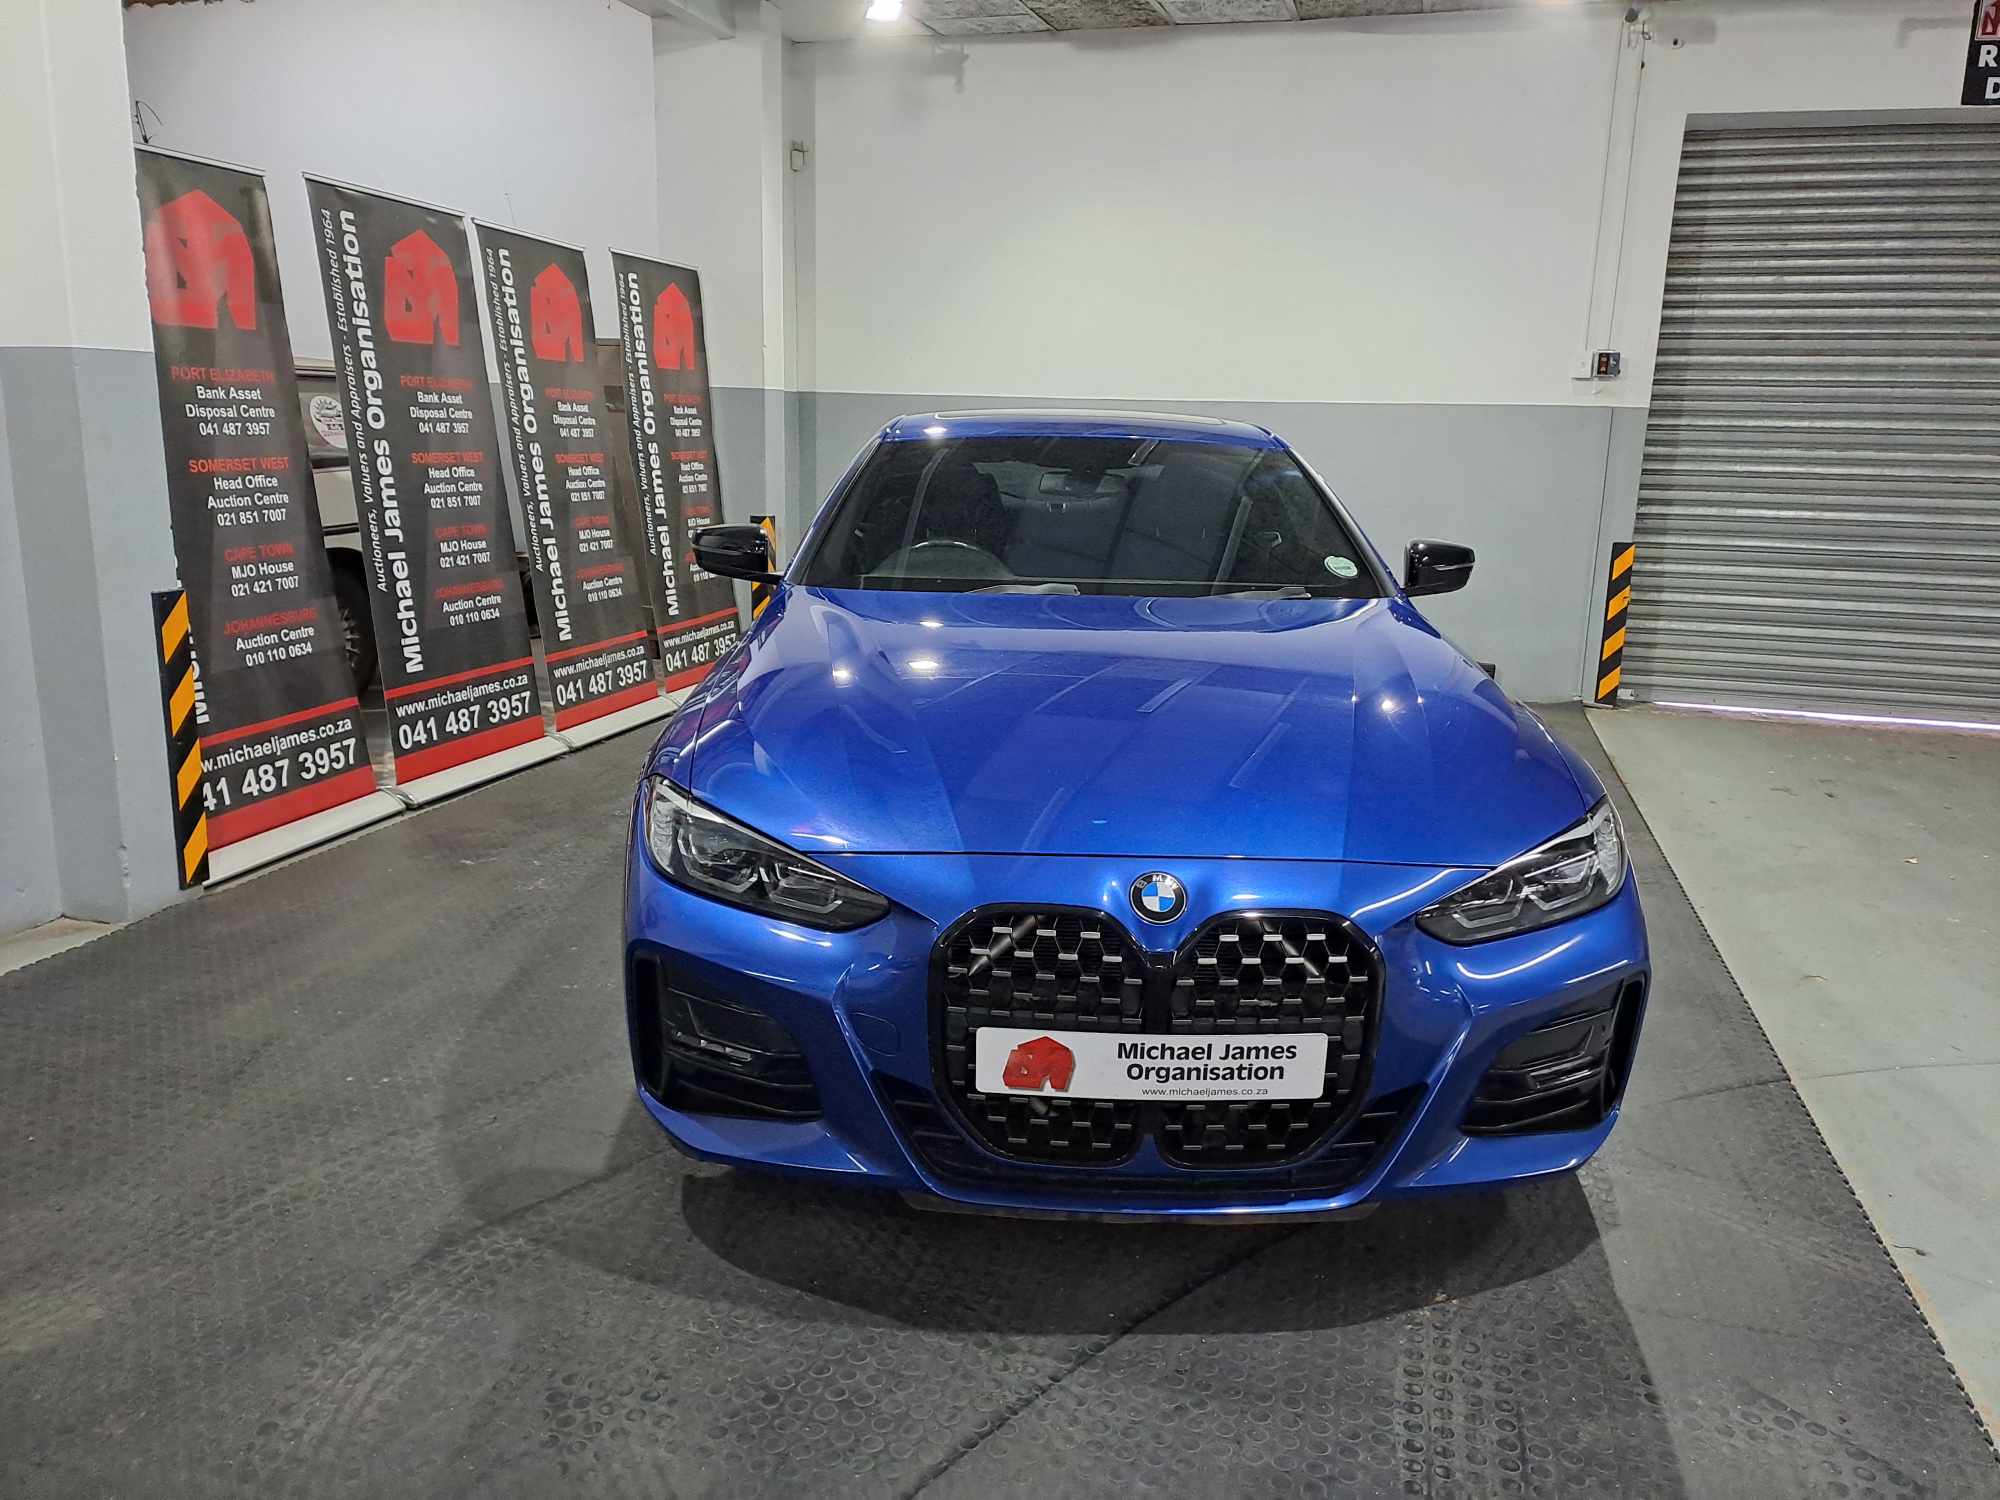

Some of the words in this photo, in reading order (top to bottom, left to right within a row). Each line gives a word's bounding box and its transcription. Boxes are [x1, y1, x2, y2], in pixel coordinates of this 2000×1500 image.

[321, 208, 336, 248] 1964
[486, 248, 496, 282] 1964
[330, 249, 348, 332] Established
[491, 282, 508, 352] Established
[171, 367, 206, 380] PORT
[342, 343, 361, 419] Appraisers
[197, 386, 226, 399] Bank
[229, 387, 261, 400] Asset
[417, 392, 440, 403] Bank
[441, 392, 462, 404] Asset
[185, 404, 237, 420] Disposal
[240, 405, 275, 418] Centre
[410, 406, 447, 420] Disposal
[448, 408, 472, 419] Centre
[200, 422, 219, 435] 041
[222, 422, 241, 435] 487
[246, 422, 270, 434] 3957
[352, 421, 366, 449] and
[419, 422, 434, 433] 041
[436, 422, 450, 433] 487
[513, 426, 524, 450] and
[188, 458, 256, 473] SOMERSET
[359, 452, 374, 503] Valuers
[428, 468, 450, 478] Head
[452, 466, 476, 478] Office
[519, 454, 531, 497] Valuers
[214, 477, 242, 490] Head
[246, 475, 278, 488] Office
[374, 439, 404, 542] James
[424, 482, 456, 494] Auction
[458, 481, 484, 492] Centre
[530, 442, 554, 530] James
[648, 442, 667, 519] James
[208, 494, 251, 509] Auction
[254, 492, 289, 505] Centre
[430, 498, 444, 509] 021
[448, 497, 462, 508] 851
[464, 495, 481, 506] 7007
[217, 512, 236, 526] 021
[240, 511, 259, 524] 851
[262, 508, 286, 522] 7007
[440, 542, 458, 553] MJO
[460, 539, 487, 550] House
[526, 500, 544, 572] Auctioneers,
[367, 508, 387, 592] Auctioneers,
[440, 556, 454, 568] 021
[456, 555, 470, 566] 421
[473, 552, 491, 564] 7007
[232, 564, 256, 579] MJO
[258, 562, 294, 576] House
[658, 526, 680, 616] Michael
[232, 584, 250, 597] 021
[253, 580, 272, 594] 421
[276, 576, 299, 590] 7007
[543, 538, 572, 642] Michael
[388, 552, 424, 674] Michael
[442, 600, 474, 613] Auction
[476, 594, 502, 608] Centre
[450, 614, 464, 626] 010
[466, 612, 480, 624] 110
[481, 608, 500, 622] 0634
[236, 634, 278, 650] Auction
[281, 626, 314, 642] Centre
[246, 653, 264, 666] 010
[268, 648, 286, 662] 110
[288, 641, 312, 658] 0634
[553, 644, 645, 679] www.michaeljames.co.za
[665, 650, 688, 672] 041
[692, 642, 710, 663] 487
[556, 679, 584, 706] 041
[588, 670, 612, 695] 487
[616, 660, 648, 687] 3957
[396, 674, 528, 718] www.michaeljames.co.za
[398, 716, 438, 750] 041
[445, 704, 480, 735] 487
[488, 690, 531, 724] 3957
[242, 758, 290, 796] 487
[298, 738, 356, 780] 3957
[1116, 1042, 1212, 1061] Michael
[1219, 1042, 1297, 1060] James
[1126, 1062, 1285, 1084] Organisation
[1142, 1086, 1268, 1097] www.michaeljames.co.za
